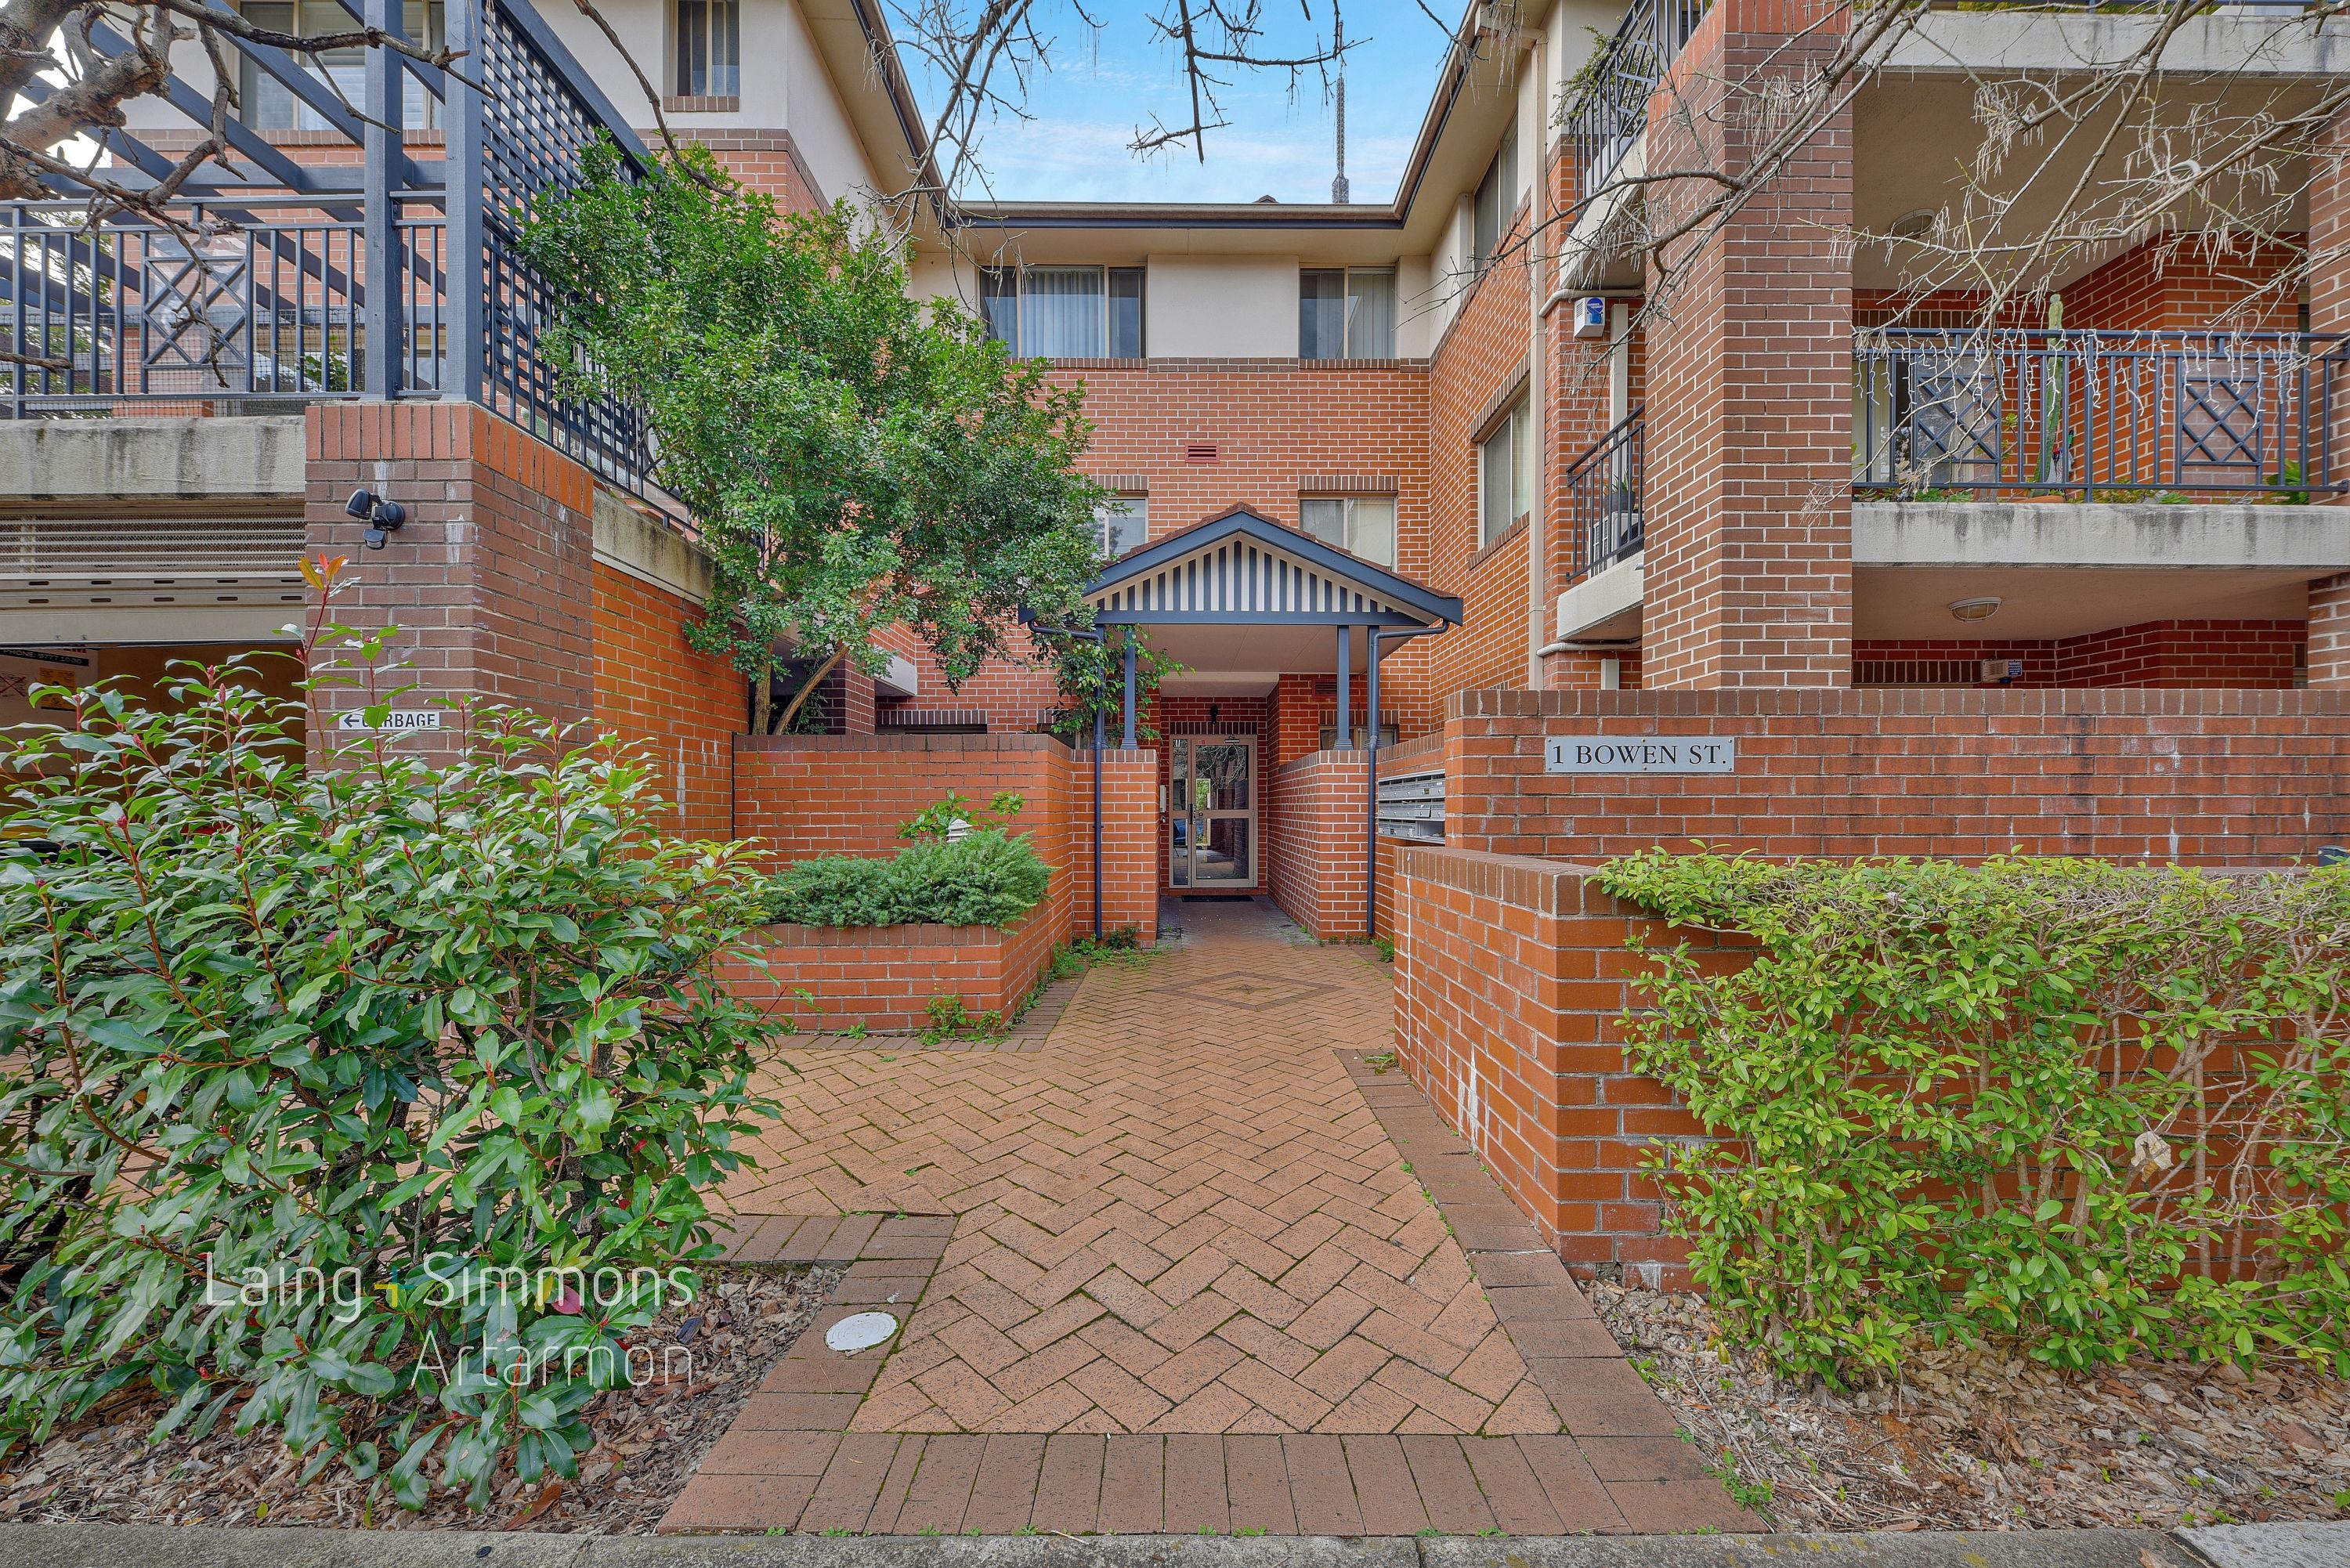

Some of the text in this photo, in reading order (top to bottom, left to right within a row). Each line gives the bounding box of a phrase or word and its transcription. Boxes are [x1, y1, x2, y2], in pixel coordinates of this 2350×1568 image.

[362, 714, 436, 728] RBAGE
[1553, 744, 1727, 765] 1 BOWEN ST.
